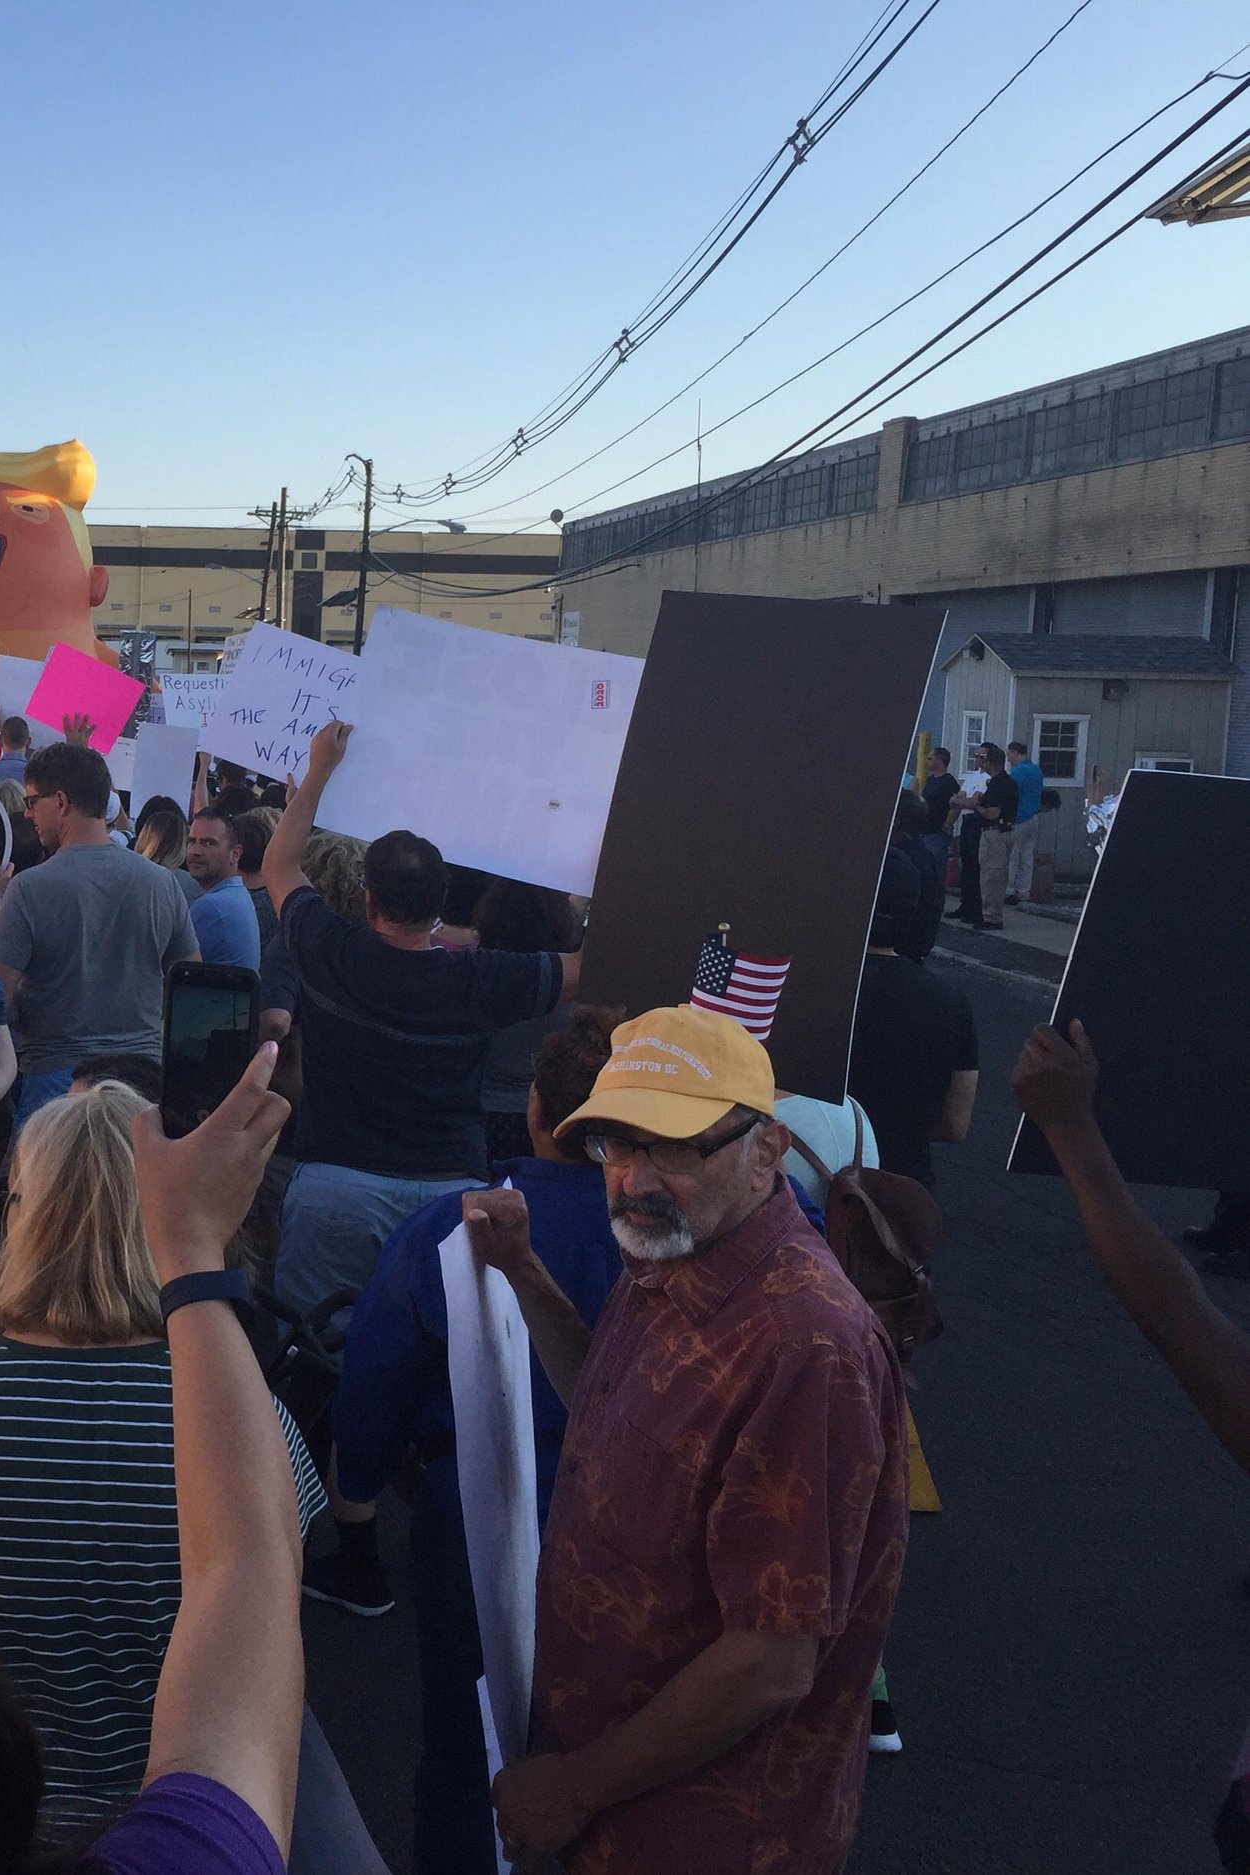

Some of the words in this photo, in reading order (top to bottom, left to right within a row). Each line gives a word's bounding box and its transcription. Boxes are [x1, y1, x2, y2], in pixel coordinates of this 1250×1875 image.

[163, 675, 229, 693] Requesti
[230, 709, 266, 724] THE
[254, 741, 308, 771] WAY
